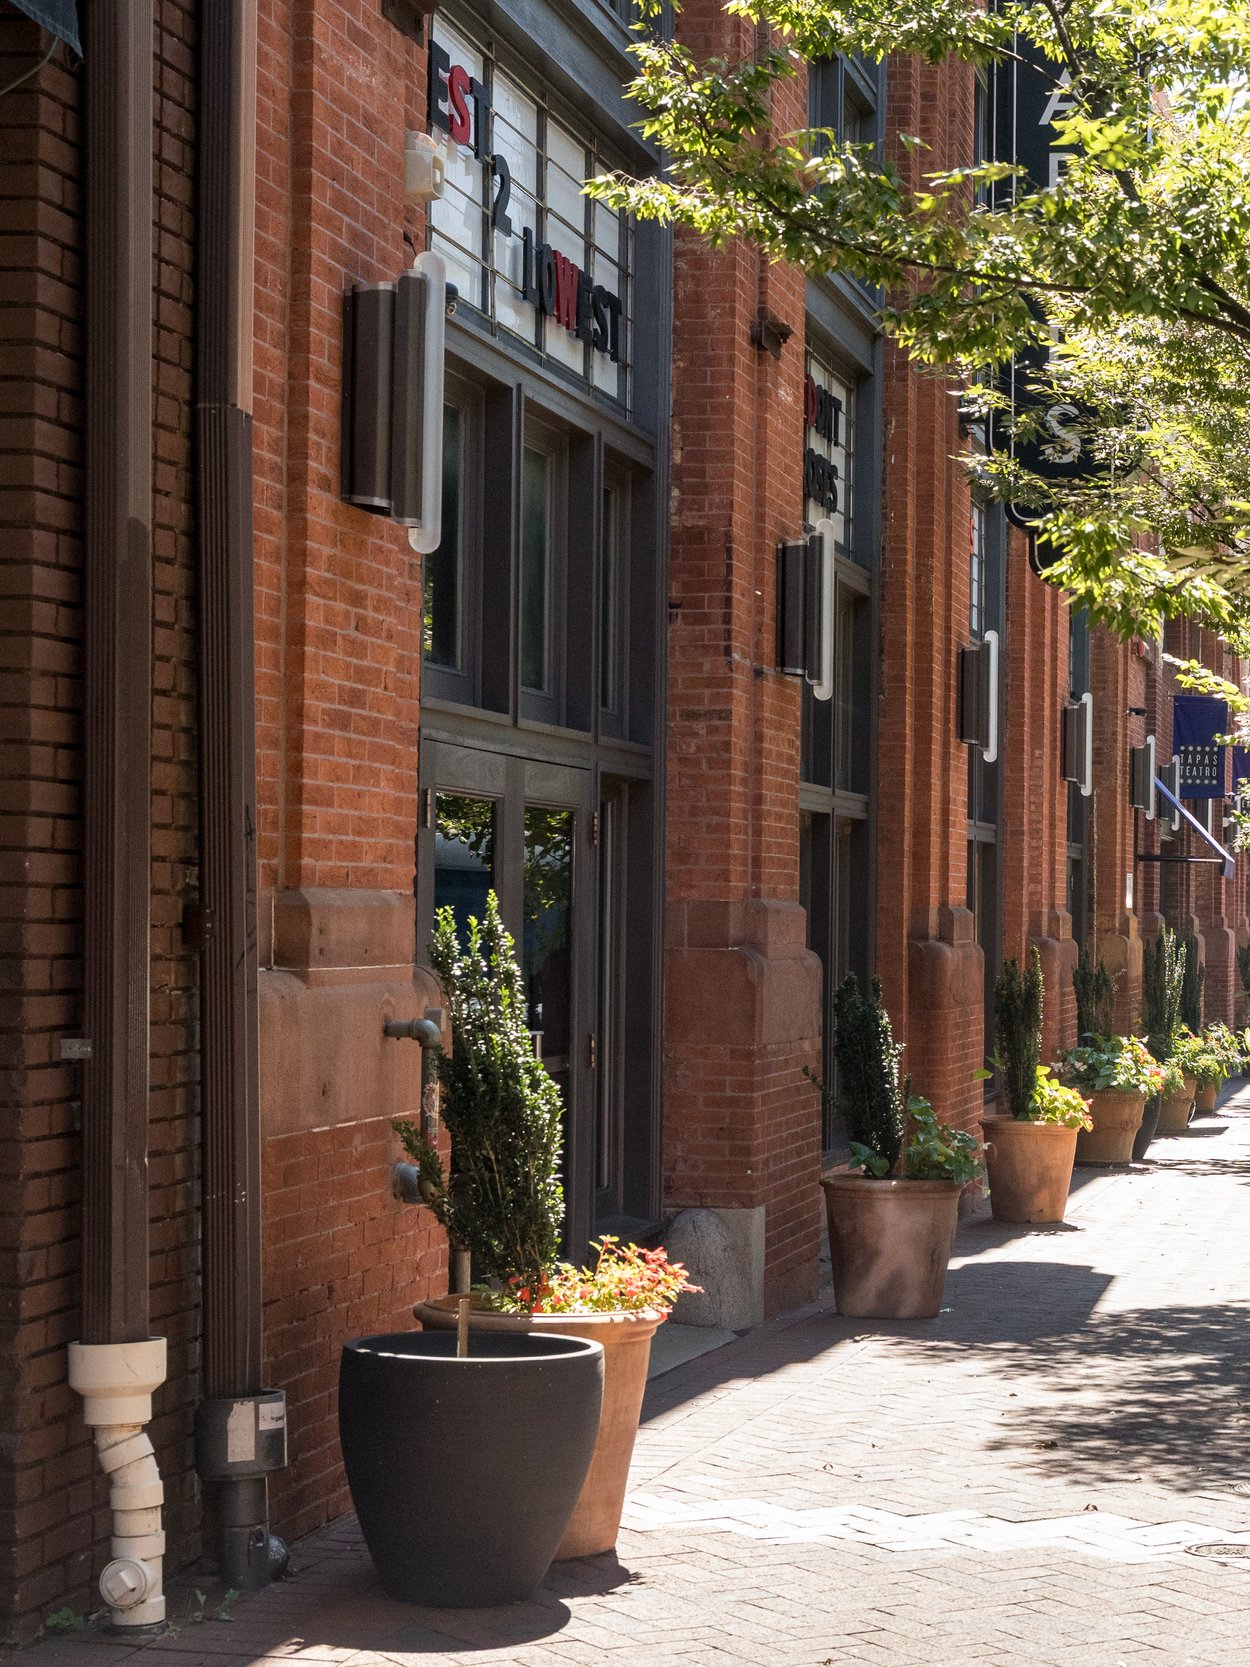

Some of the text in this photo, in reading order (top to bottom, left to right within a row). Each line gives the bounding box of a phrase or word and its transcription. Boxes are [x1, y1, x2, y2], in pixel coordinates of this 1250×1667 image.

[491, 154, 512, 237] 2
[523, 226, 622, 363] LOWEST
[1180, 753, 1218, 765] TAPAS
[1180, 766, 1217, 777] TEATRO
